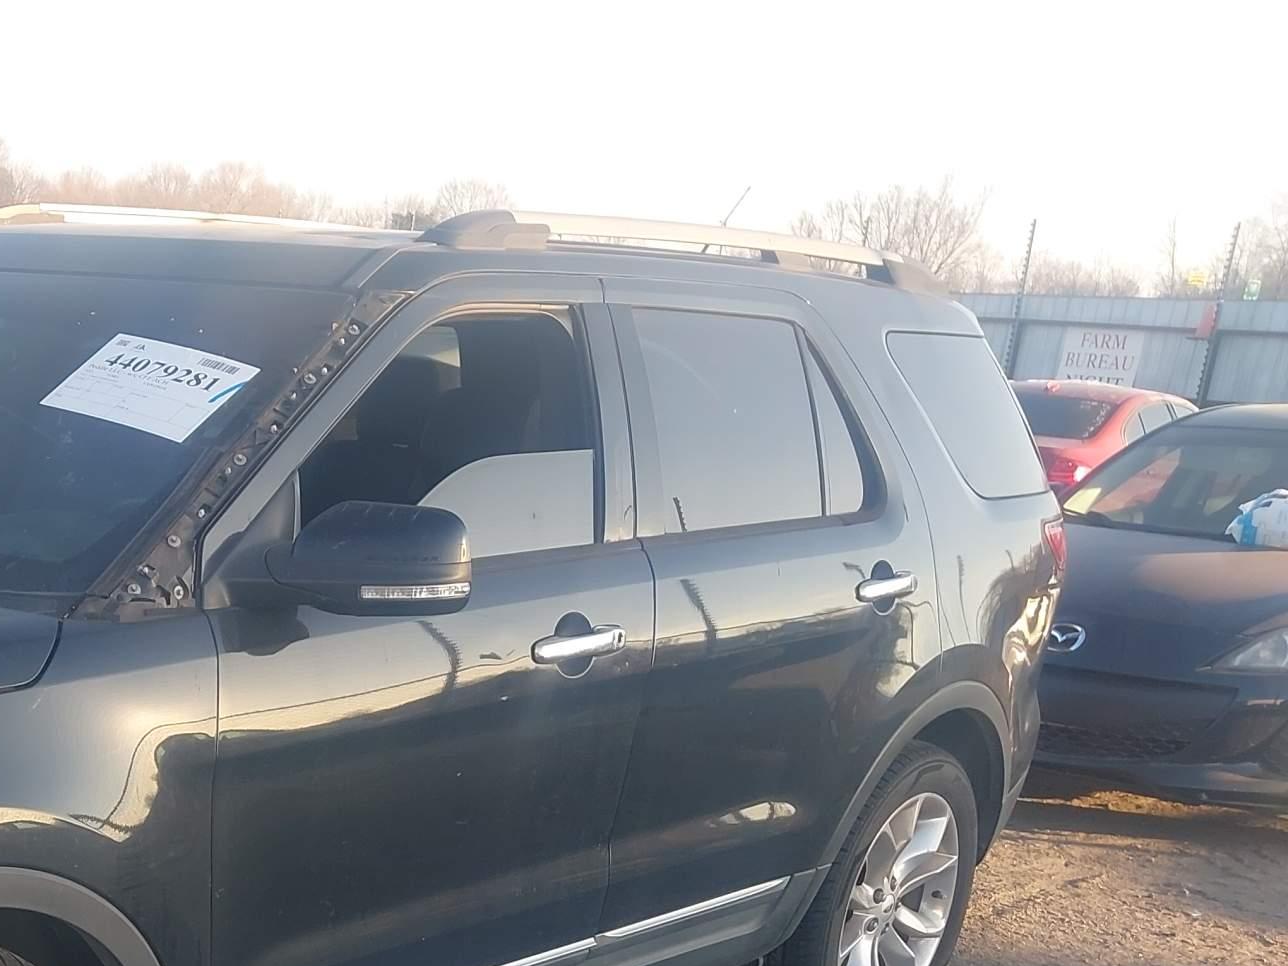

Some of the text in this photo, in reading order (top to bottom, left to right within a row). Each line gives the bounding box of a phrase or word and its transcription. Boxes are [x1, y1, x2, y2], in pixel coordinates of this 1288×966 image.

[1080, 332, 1128, 350] FARM
[1065, 351, 1135, 371] BUREAU
[104, 353, 221, 392] 44079281
